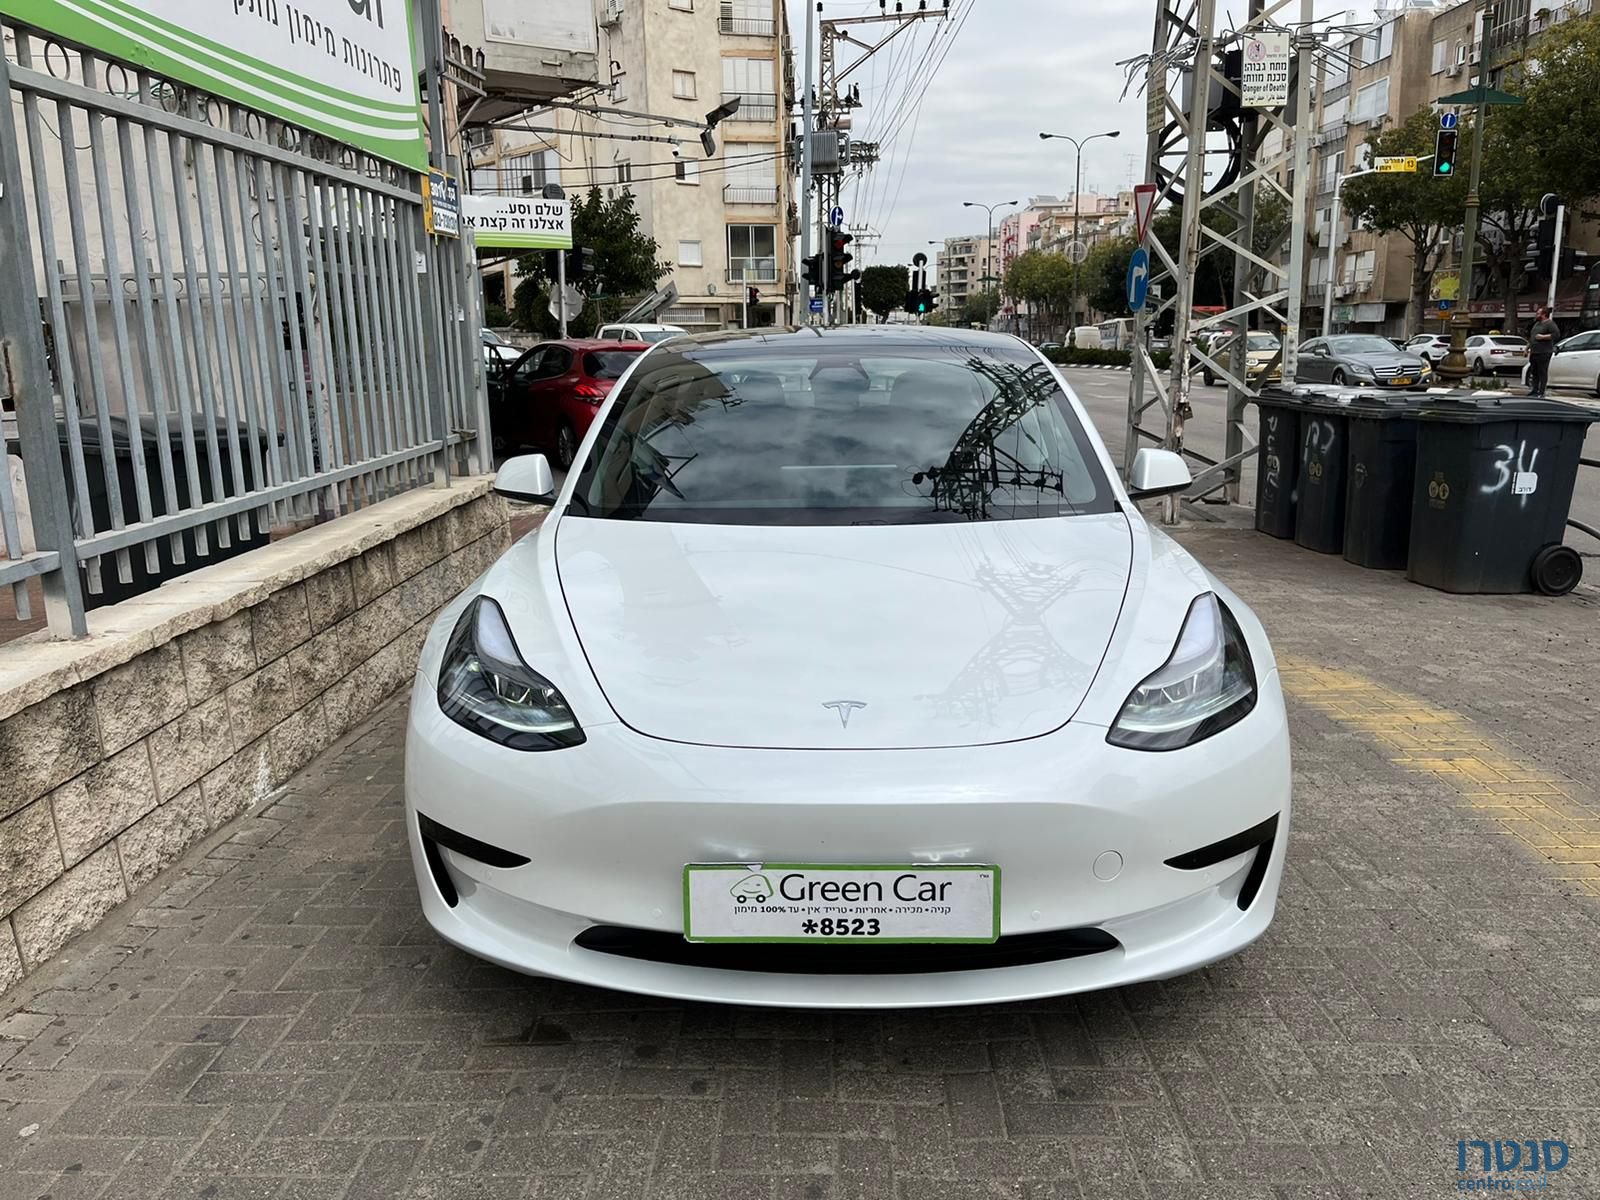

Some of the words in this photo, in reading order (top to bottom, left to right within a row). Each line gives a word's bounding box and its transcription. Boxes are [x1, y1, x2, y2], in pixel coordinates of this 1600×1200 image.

[286, 4, 337, 57] מימון
[342, 37, 401, 93] פתרונות
[1243, 73, 1264, 82] מוות!
[1266, 73, 1287, 82] סכנת
[1243, 84, 1262, 94] Danger
[1263, 83, 1269, 92] of
[496, 203, 531, 215] וסע...
[535, 203, 563, 216] שלם
[480, 216, 507, 231] קצת
[511, 218, 526, 228] זה
[529, 217, 564, 230] אצלנו
[779, 873, 883, 902] Green
[892, 873, 953, 902] Car
[734, 906, 758, 915] מימון
[807, 906, 821, 915] אין
[824, 906, 847, 914] טרייד
[855, 906, 888, 914] אחריות
[895, 906, 923, 914] מכירה
[930, 906, 951, 915] קניה
